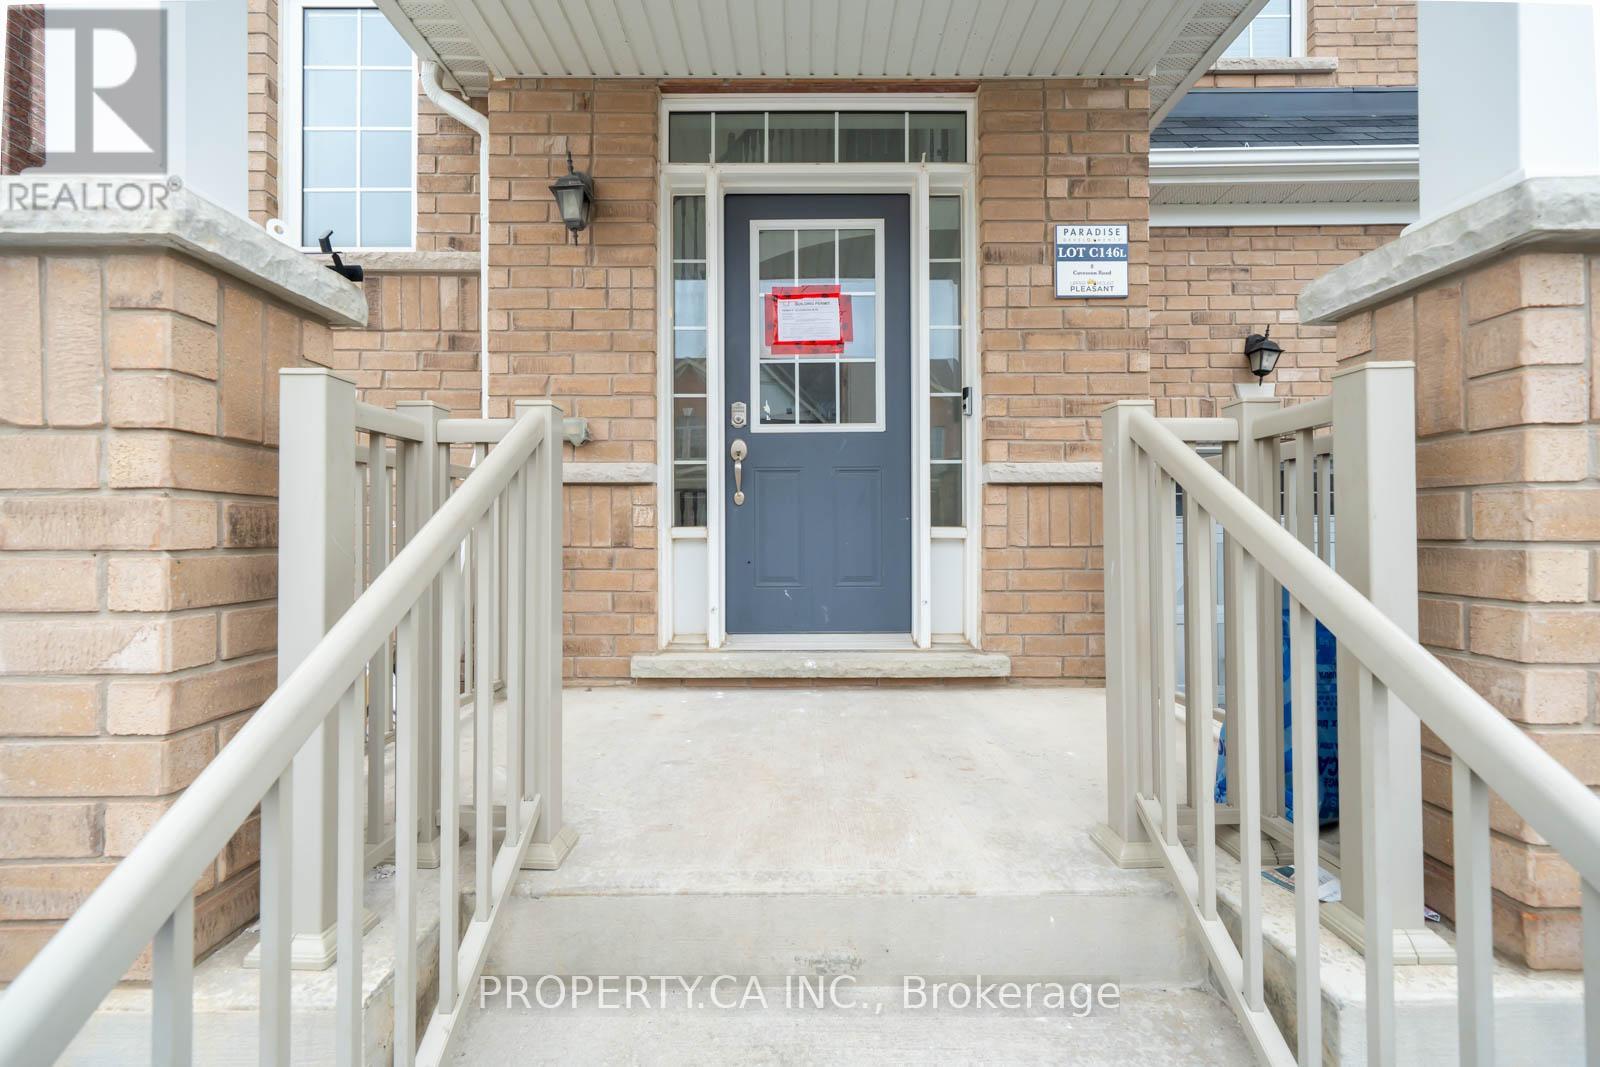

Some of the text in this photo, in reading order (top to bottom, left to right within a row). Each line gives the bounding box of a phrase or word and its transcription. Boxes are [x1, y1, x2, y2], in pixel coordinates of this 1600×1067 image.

[1063, 228, 1121, 236] PARADISE
[1058, 247, 1086, 258] LOT
[1070, 285, 1115, 293] PLEASANT
